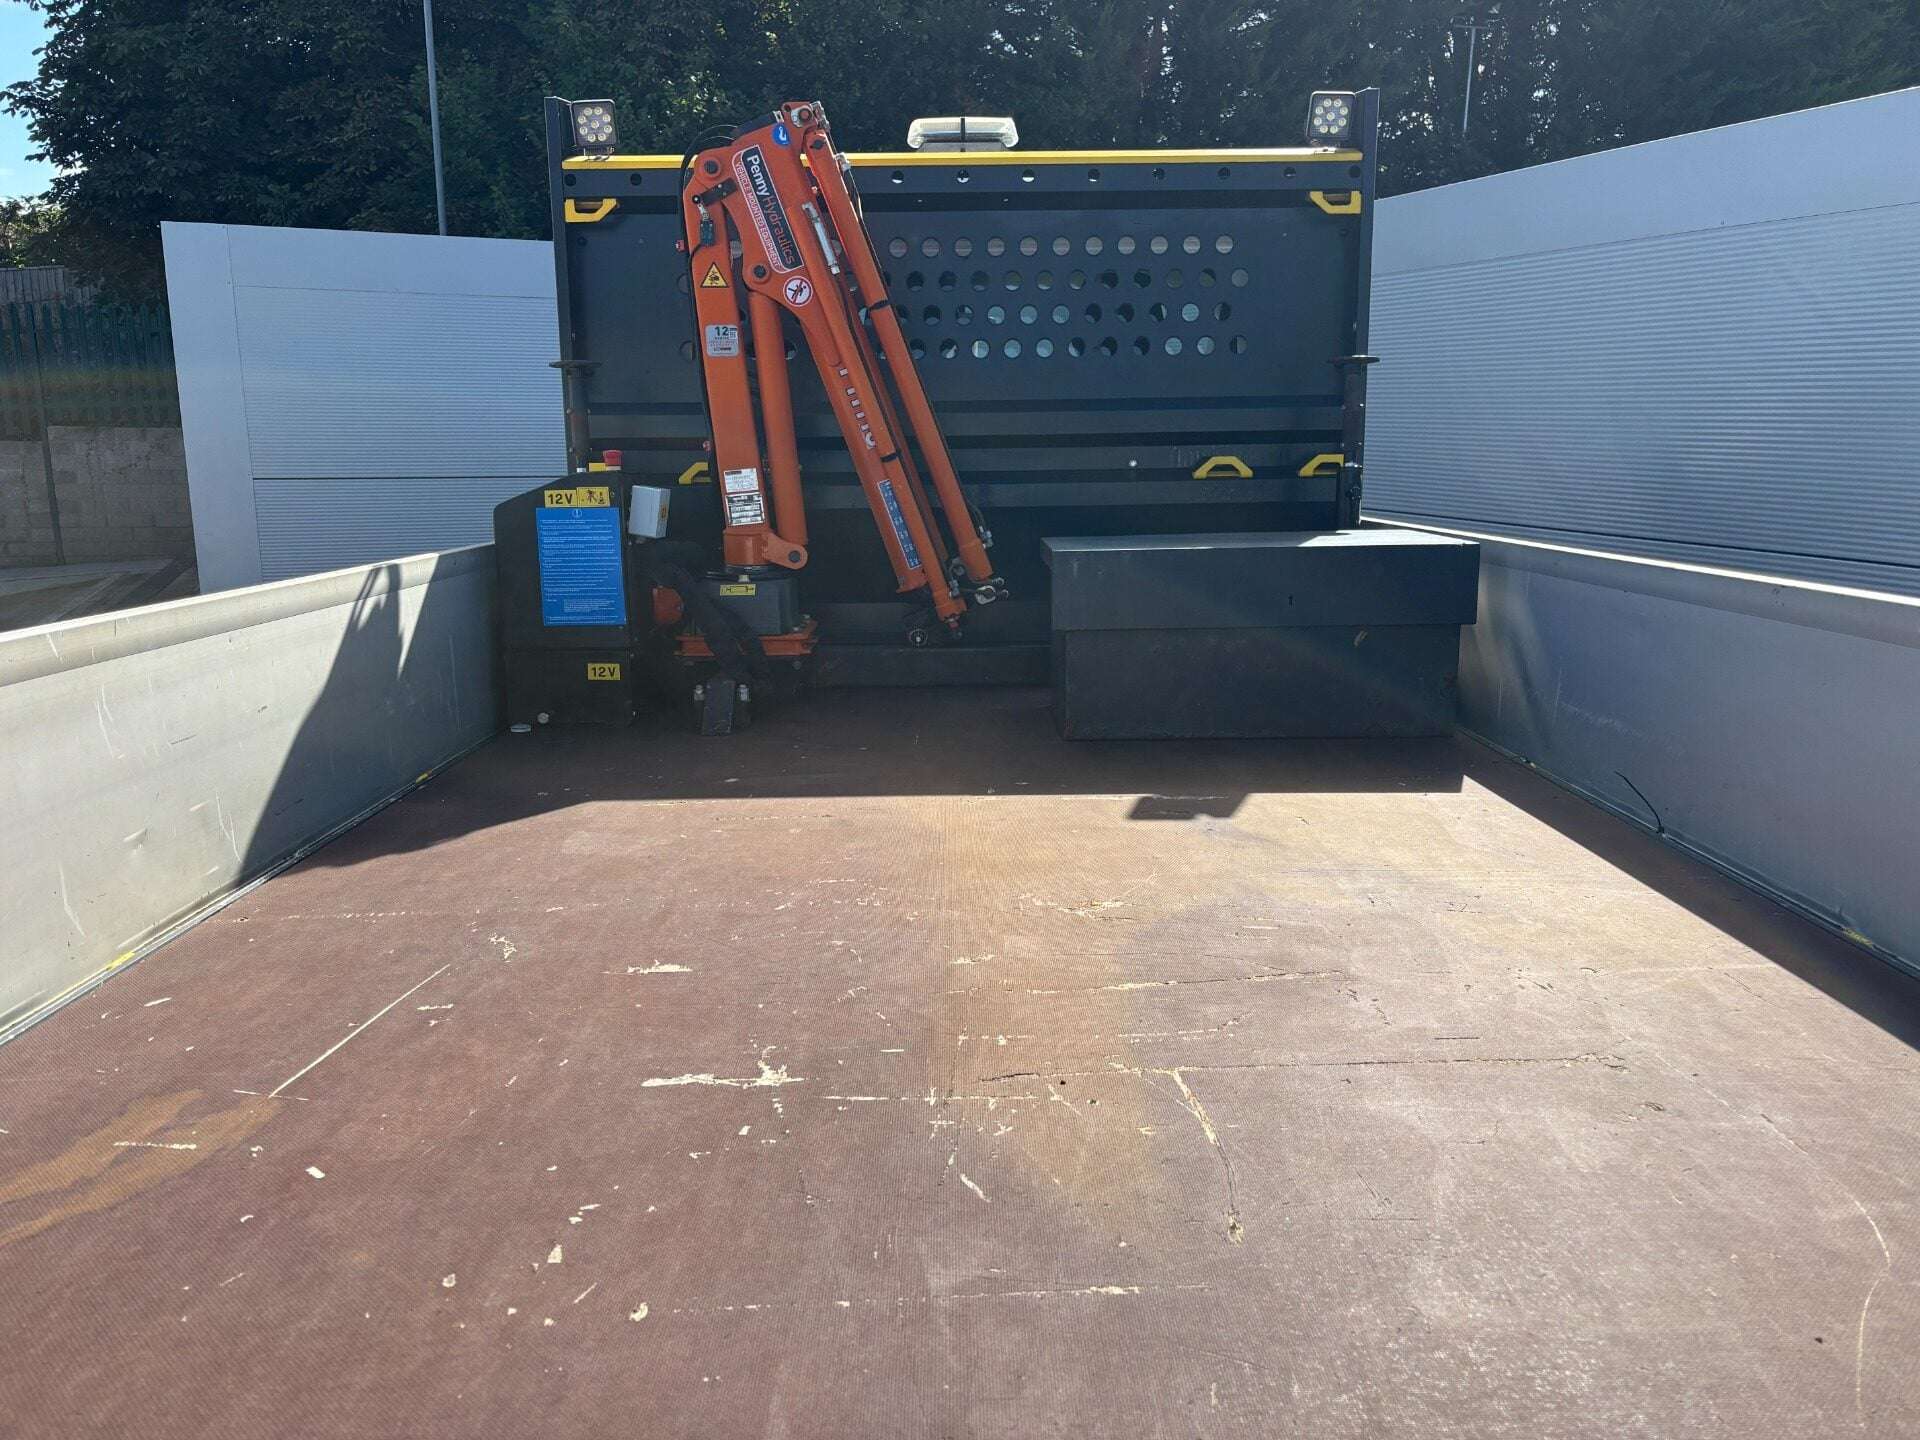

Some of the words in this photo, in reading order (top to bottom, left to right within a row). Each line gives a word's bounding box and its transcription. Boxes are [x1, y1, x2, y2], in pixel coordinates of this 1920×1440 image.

[735, 161, 751, 191] VEHICLE
[747, 192, 764, 226] MOUNTED
[759, 226, 780, 268] EQUIPMENT
[746, 154, 770, 196] Penny
[763, 195, 795, 265] Hydraulics
[714, 326, 729, 336] 12
[547, 493, 573, 505] 12V
[591, 667, 616, 677] 12V
